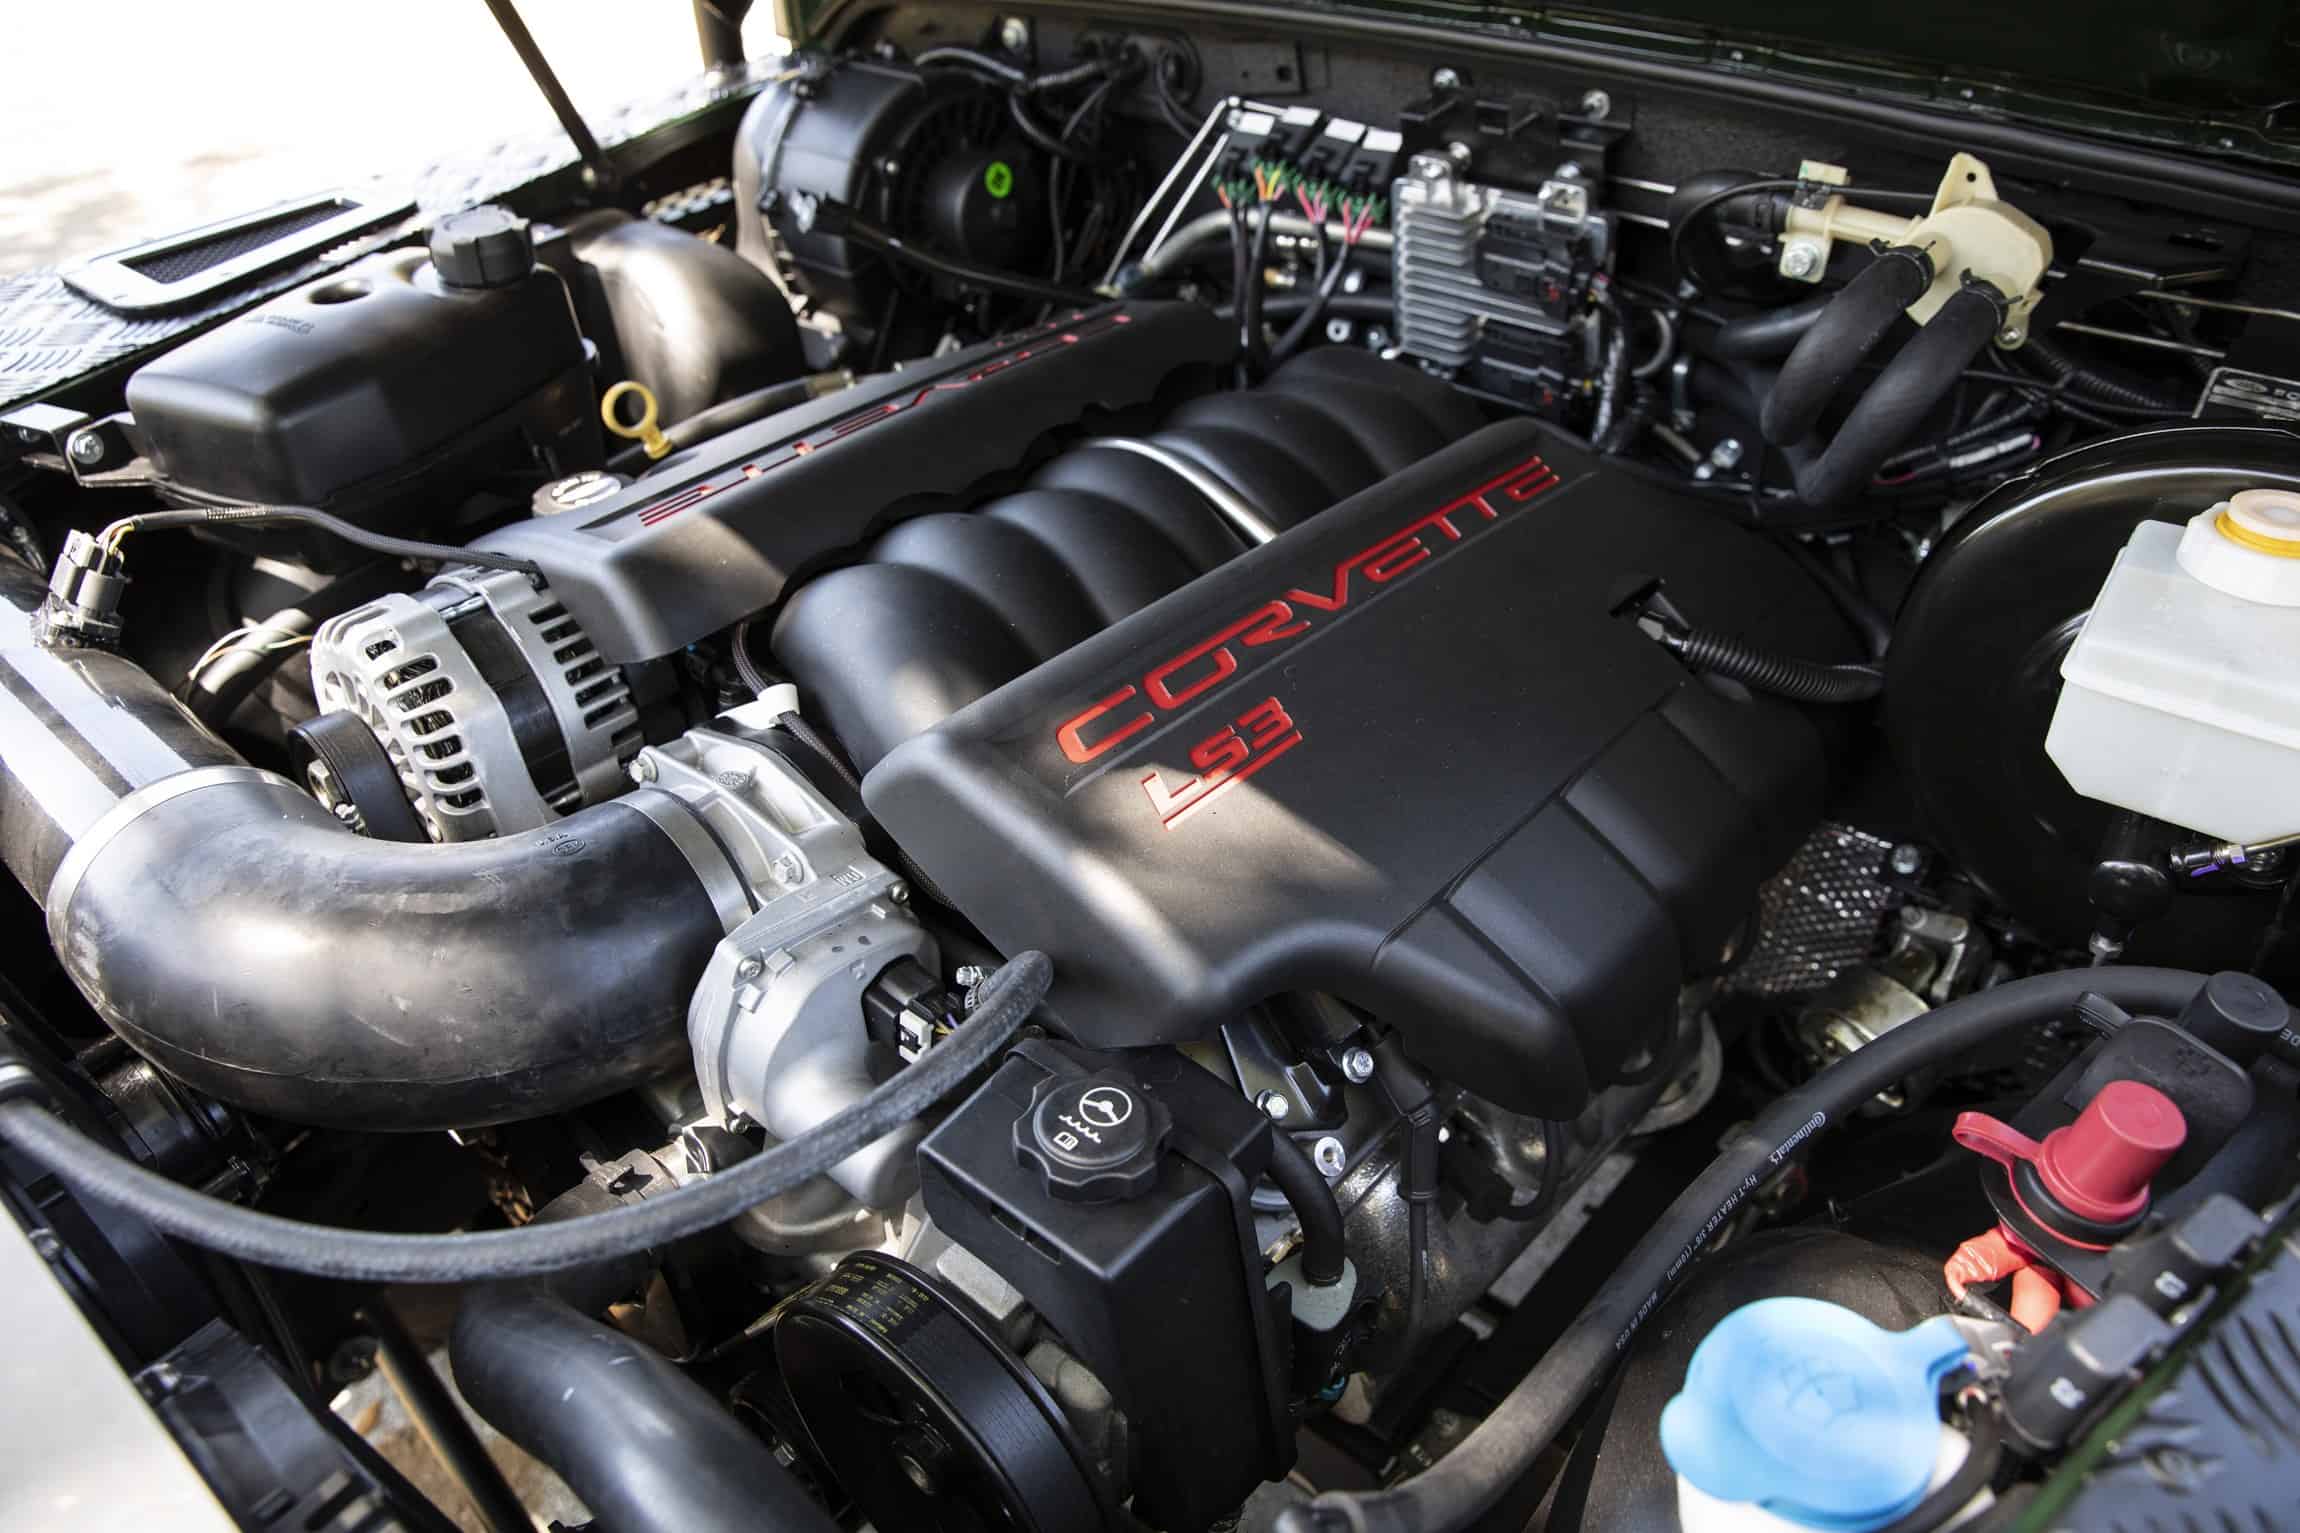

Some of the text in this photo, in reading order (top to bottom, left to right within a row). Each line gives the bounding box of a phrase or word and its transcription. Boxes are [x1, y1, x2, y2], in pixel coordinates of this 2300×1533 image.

[1056, 455, 1560, 764] CORVETTE
[1140, 695, 1294, 817] LS3
[1774, 1111, 1826, 1160] Continental
[1706, 1193, 1738, 1232] HEATER
